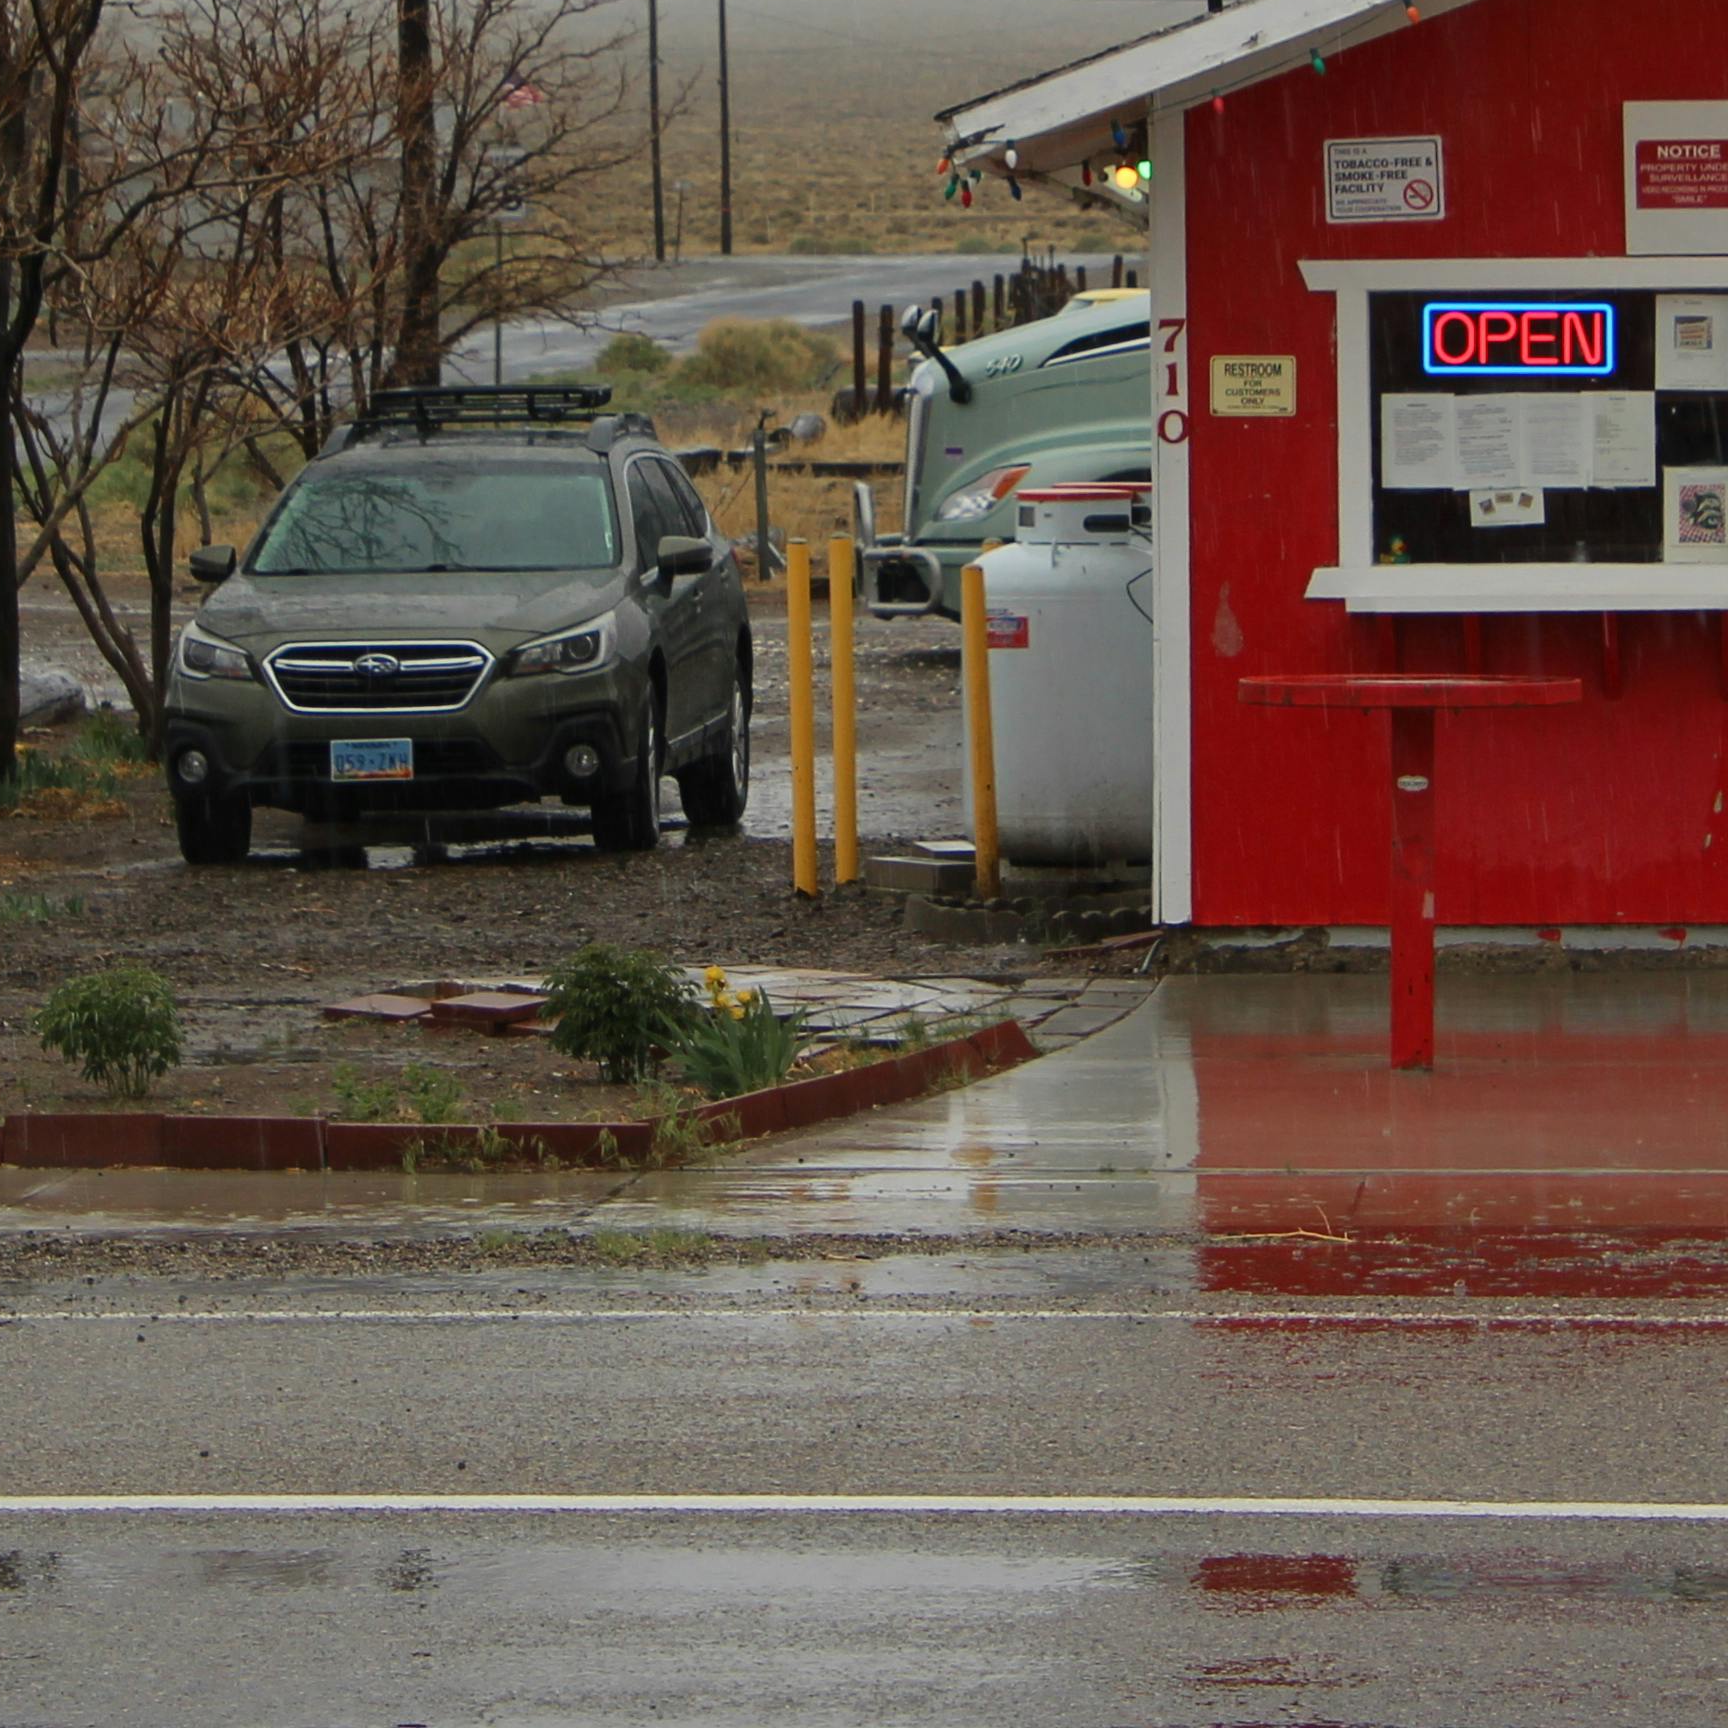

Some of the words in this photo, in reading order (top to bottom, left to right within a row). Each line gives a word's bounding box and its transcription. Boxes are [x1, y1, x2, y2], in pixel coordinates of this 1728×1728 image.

[1657, 145, 1721, 159] NOTICE
[1334, 157, 1422, 170] TOBACCO-FREE
[1425, 156, 1432, 167] &
[1640, 163, 1698, 172] PROPERTY
[1335, 170, 1408, 182] SMOKE-FREE
[1335, 183, 1384, 195] FACILITY
[1432, 309, 1604, 366] OPEN
[1224, 362, 1282, 377] RESTROOM
[1158, 318, 1189, 444] 710
[1243, 379, 1263, 387] FOR
[1225, 388, 1281, 396] CUSTOMERS
[1241, 397, 1264, 405] ONLY
